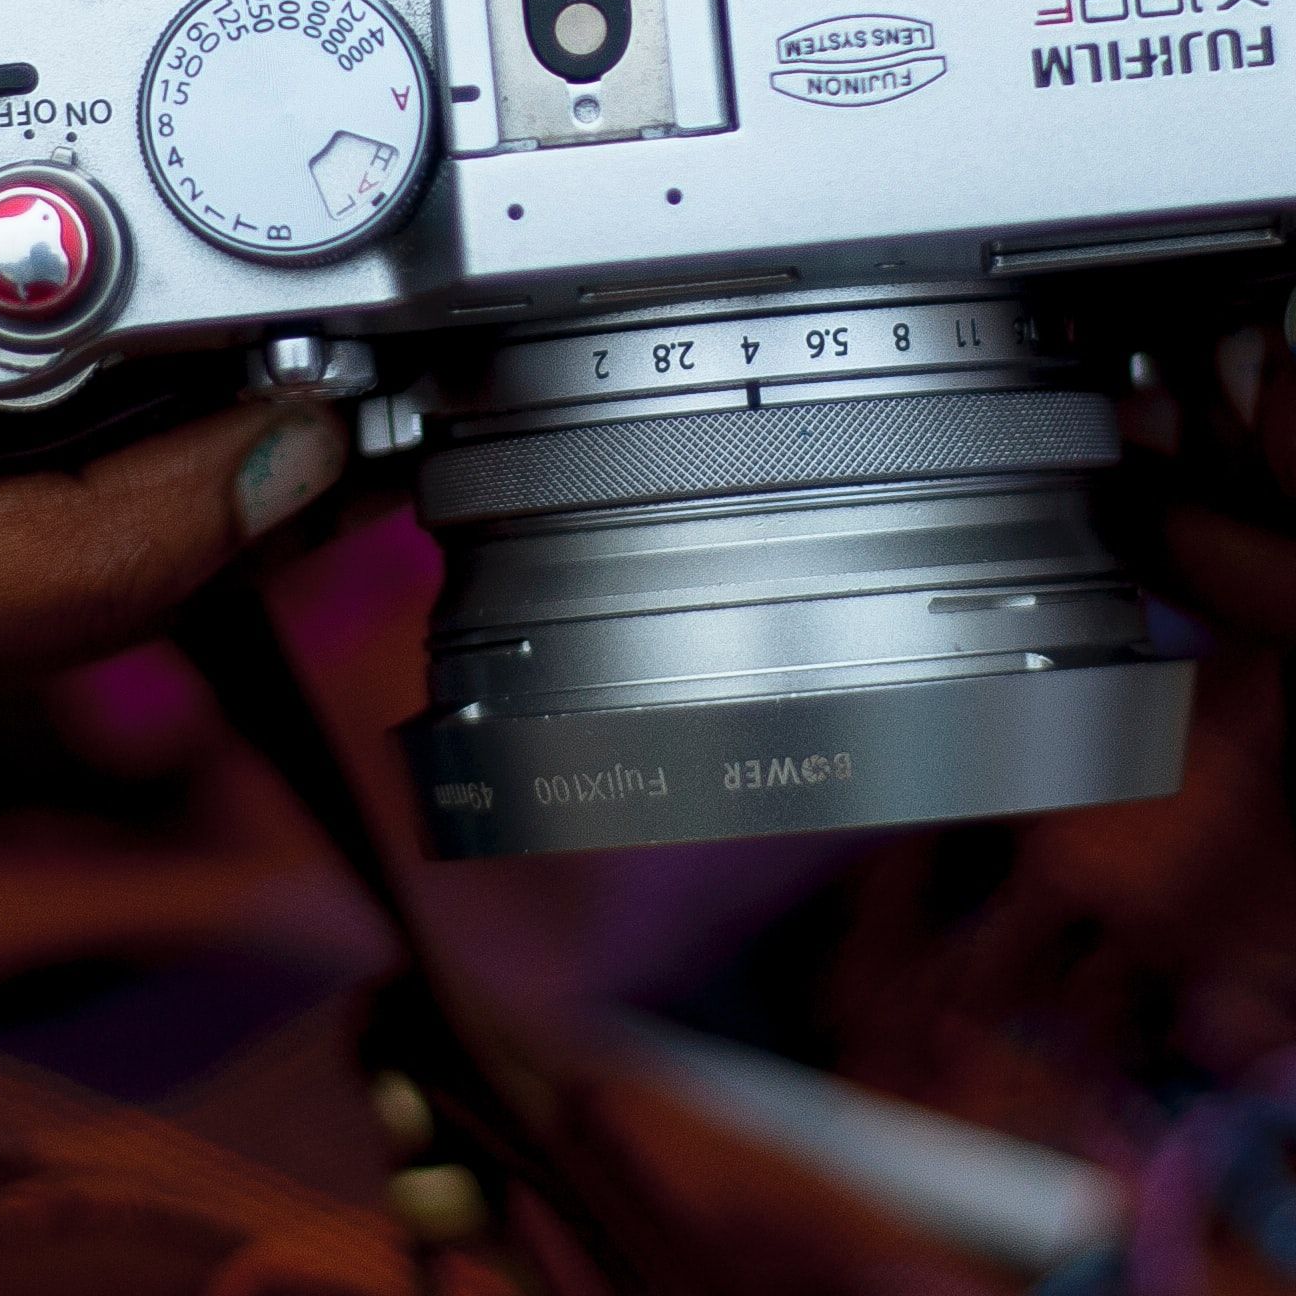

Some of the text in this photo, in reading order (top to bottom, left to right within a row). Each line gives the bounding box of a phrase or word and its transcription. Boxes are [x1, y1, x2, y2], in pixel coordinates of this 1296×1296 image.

[213, 0, 250, 41] 125
[322, 1, 366, 54] 2000
[187, 22, 220, 53] 60
[339, 26, 385, 71] 4000
[784, 26, 926, 58] LENS SYSTEM
[167, 47, 203, 78] 30
[1031, 24, 1275, 89] FUJIFILM
[160, 80, 189, 105] 15
[806, 69, 912, 96] FUJINON
[0, 99, 56, 127] OFF
[65, 99, 113, 127] ON
[390, 86, 410, 111] A
[158, 114, 173, 137] 8
[168, 146, 184, 168] 4
[180, 178, 203, 200] 2
[267, 224, 291, 240] B
[740, 335, 760, 365] 4
[805, 327, 849, 359] 5.6
[892, 323, 910, 352] 8
[593, 349, 609, 380] 2
[652, 340, 695, 373] 2.8
